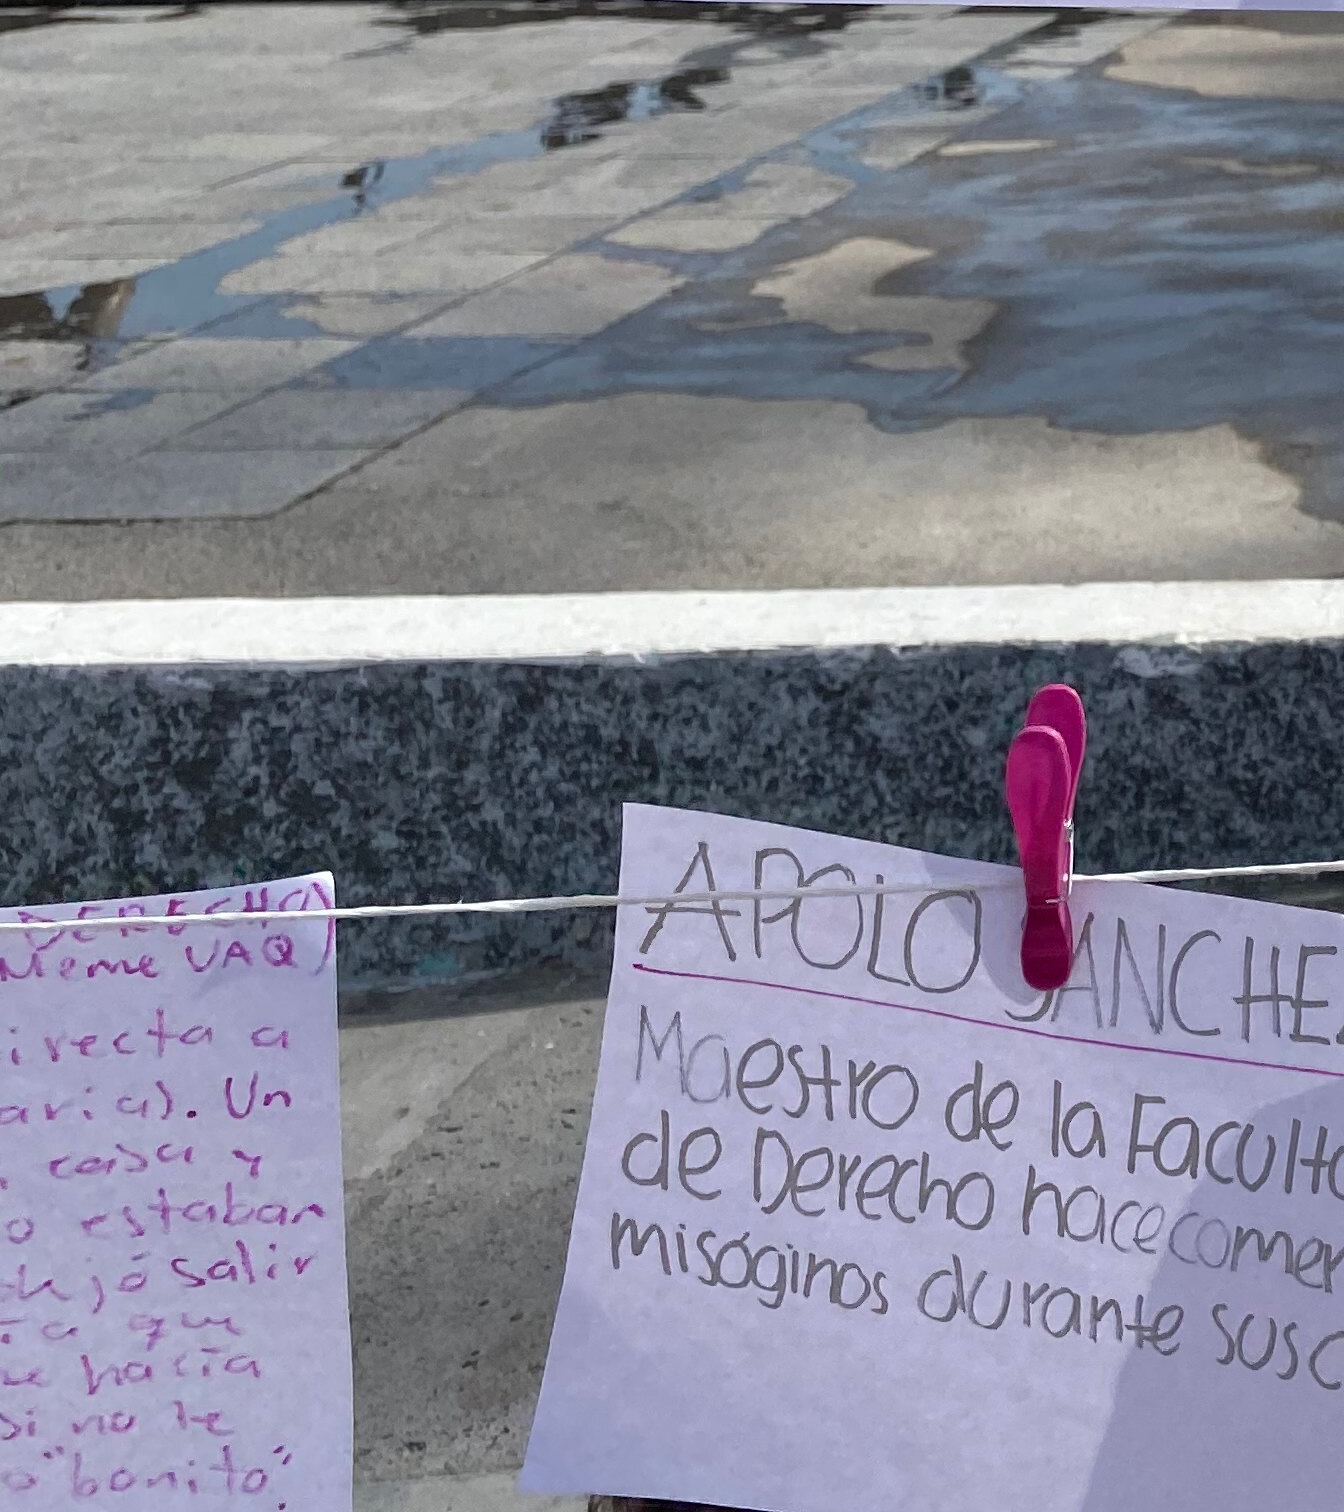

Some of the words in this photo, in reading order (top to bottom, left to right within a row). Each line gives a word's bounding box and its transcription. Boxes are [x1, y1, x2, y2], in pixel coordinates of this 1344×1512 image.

[638, 840, 982, 994] APOLO
[250, 1026, 291, 1050] a
[635, 1004, 920, 1130] Maestro
[944, 1059, 1020, 1151] de
[1051, 1078, 1107, 1159] la
[80, 1181, 325, 1240] estaban
[620, 1108, 723, 1201] de
[753, 1126, 996, 1231] Derecho
[1021, 1164, 1167, 1256] hace
[170, 1239, 319, 1289] salir
[609, 1211, 889, 1316] misóginos
[916, 1252, 1185, 1357] durante
[1211, 1302, 1300, 1381] sus
[71, 1412, 137, 1437] no
